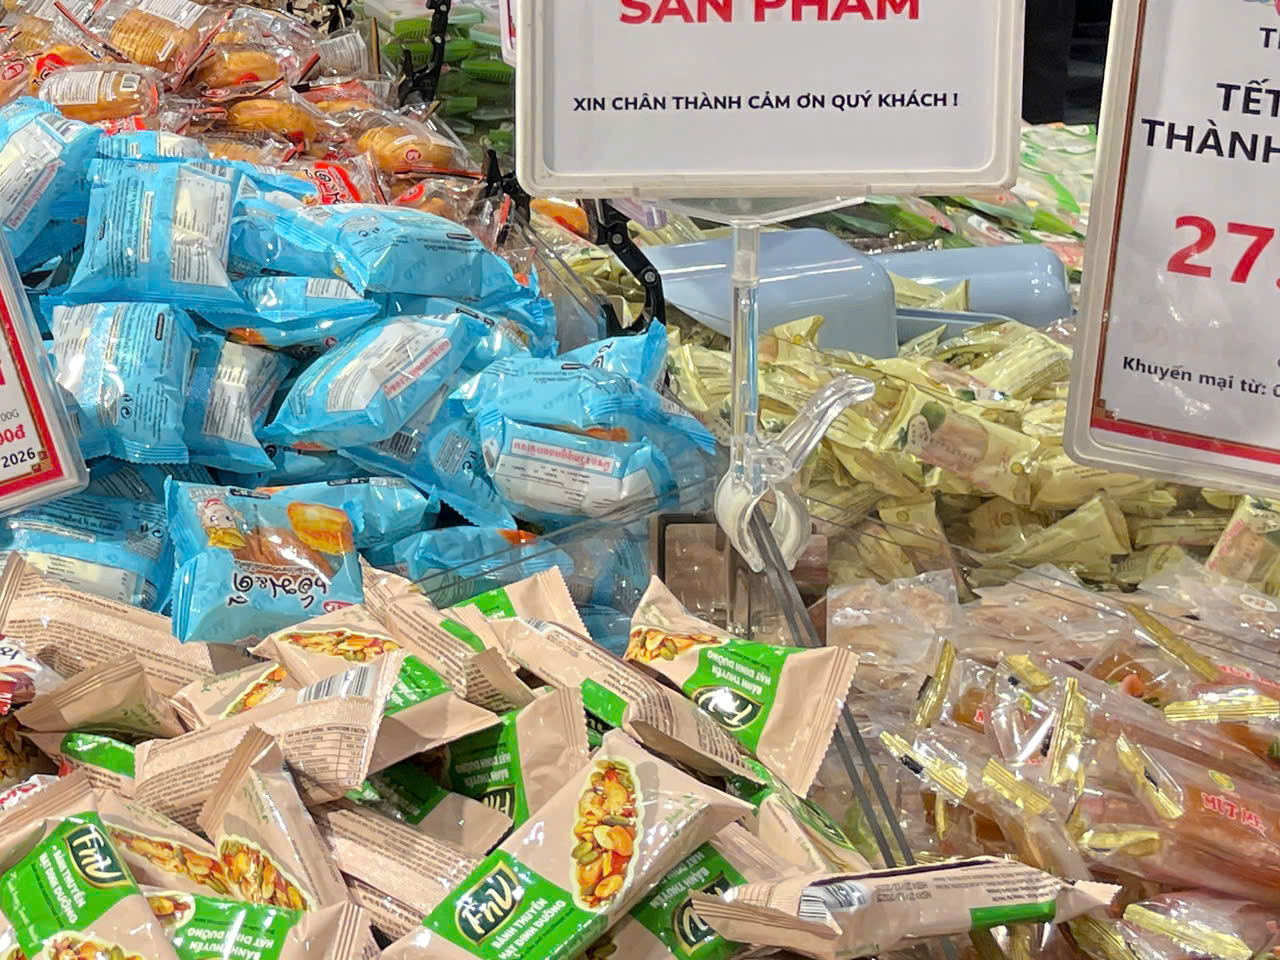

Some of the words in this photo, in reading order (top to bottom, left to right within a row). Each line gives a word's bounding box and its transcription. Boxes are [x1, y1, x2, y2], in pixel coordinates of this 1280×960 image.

[573, 95, 606, 112] XIN
[611, 92, 668, 111] CHÂN
[672, 89, 743, 111] THÀNH
[748, 90, 791, 110] CẢM
[796, 92, 827, 110] ƠN
[831, 89, 873, 112] QUÝ
[878, 88, 946, 109] KHÁCH
[1122, 354, 1193, 384] Khuyến
[1198, 369, 1234, 392] mại
[1239, 376, 1268, 397] từ:
